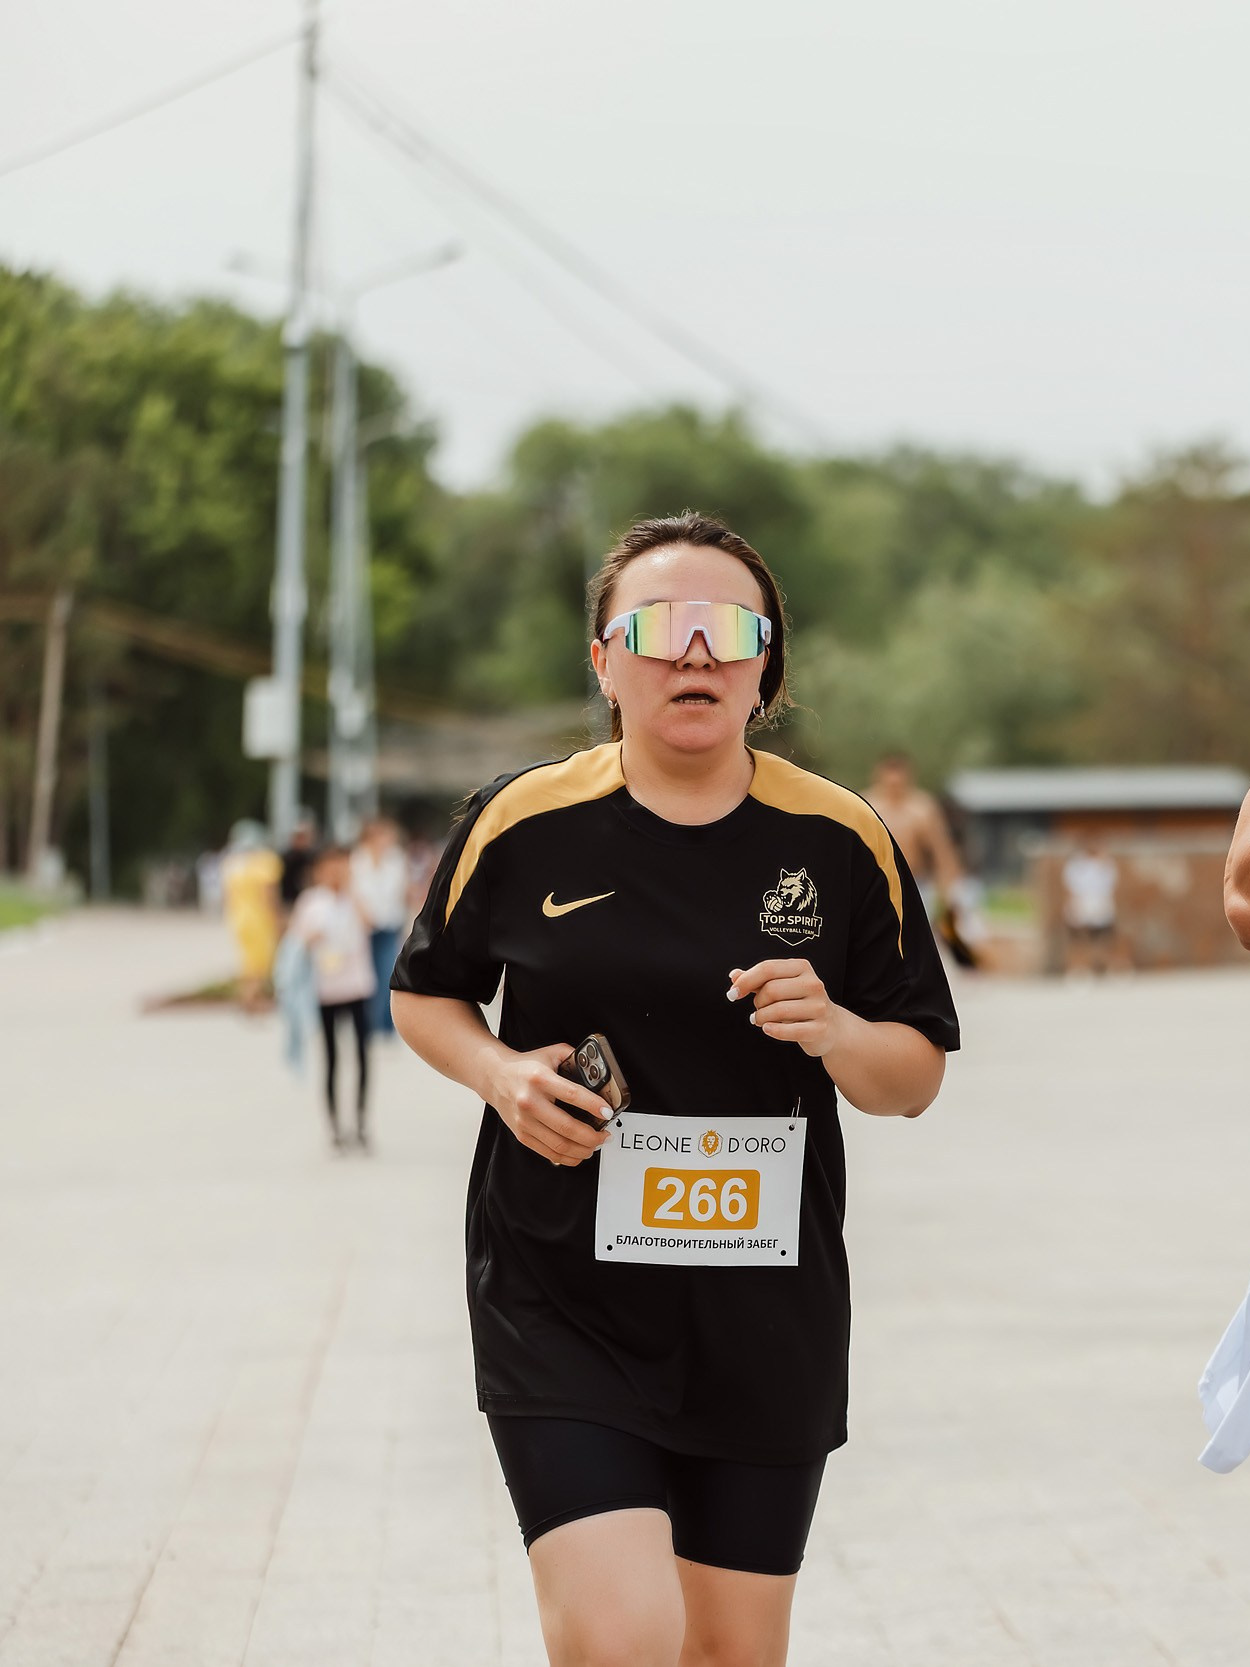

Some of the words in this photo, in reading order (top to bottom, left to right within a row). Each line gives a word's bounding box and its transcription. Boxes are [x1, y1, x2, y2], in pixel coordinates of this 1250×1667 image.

[763, 914, 786, 924] TOP
[787, 915, 819, 927] SPIRIT
[769, 926, 802, 934] VOLLEYBALL
[620, 1132, 692, 1153] LEONE
[728, 1136, 786, 1153] D'ORO
[653, 1176, 748, 1223] 266
[616, 1235, 745, 1249] БЛАГОТВОРИТЕЛЬНЫЙ
[746, 1239, 779, 1249] ЗАБЕГ
